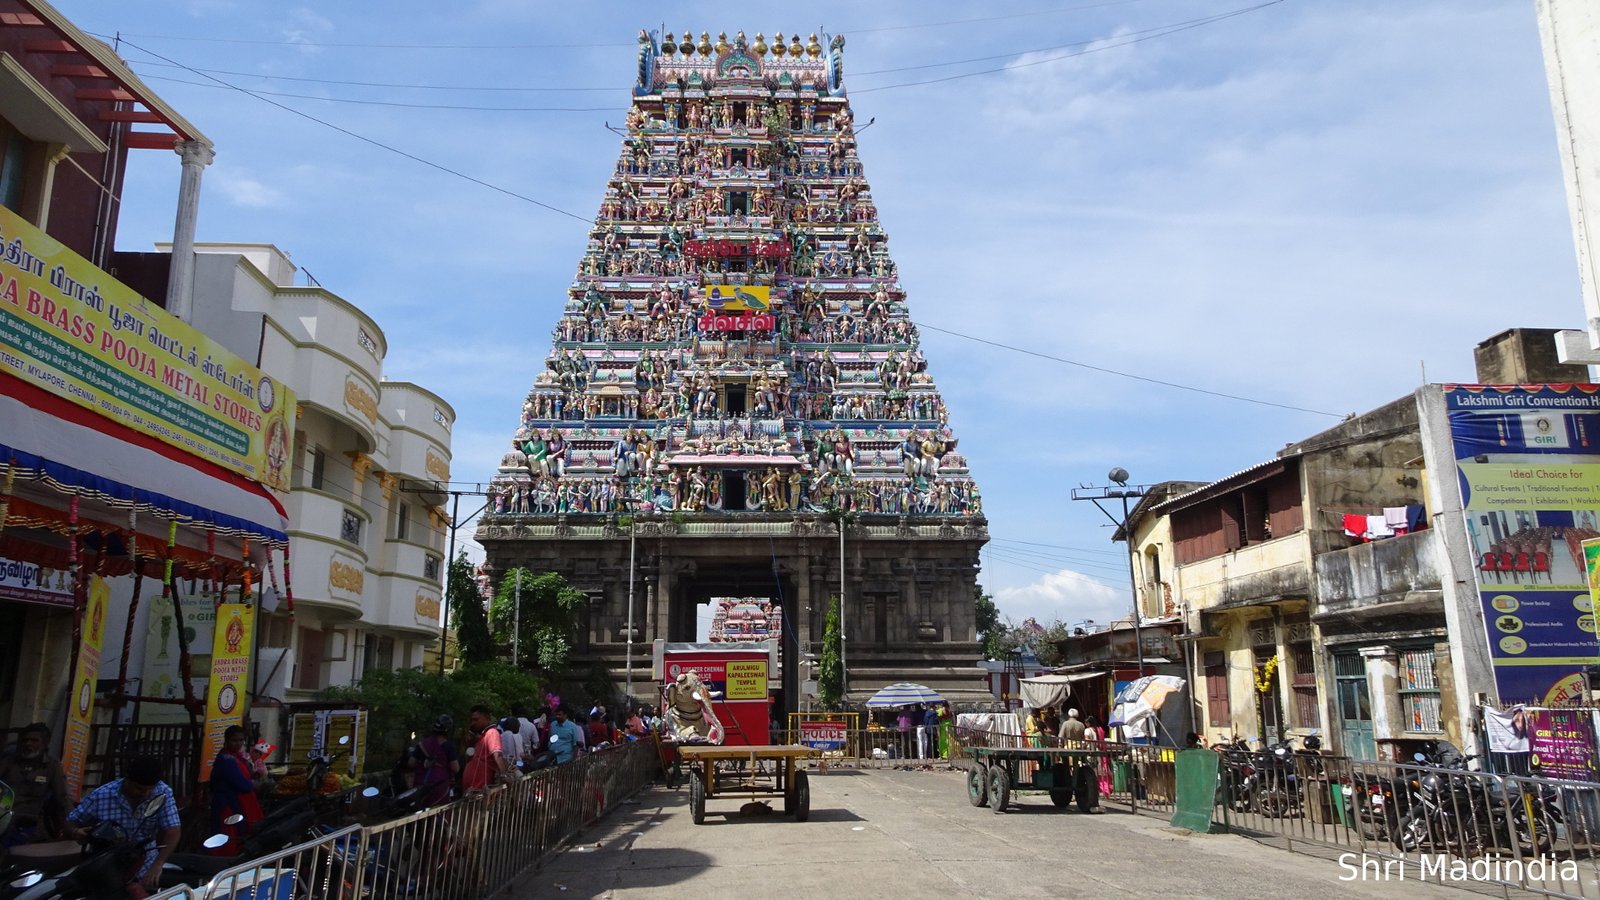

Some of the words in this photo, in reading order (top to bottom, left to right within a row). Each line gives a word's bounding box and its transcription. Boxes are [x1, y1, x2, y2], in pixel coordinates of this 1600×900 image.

[50, 266, 104, 313] பிராஸ்
[109, 303, 144, 336] பூஜா
[149, 326, 198, 368] மெட்டல்
[202, 355, 254, 399] ஸ்டோர்ஸ்
[26, 288, 96, 344] BRASS
[100, 330, 156, 379] POOJA
[162, 364, 209, 405] METAL
[214, 393, 262, 431] STORES
[28, 364, 67, 391] MYLAPORE,
[68, 384, 97, 401] CHENNAI
[1457, 394, 1502, 407] Lakshmi
[1505, 394, 1525, 407] Giri
[1527, 395, 1588, 408] Convention
[1535, 436, 1556, 444] GIRI
[1510, 469, 1534, 479] Ideal
[1536, 469, 1568, 479] Choice
[1570, 468, 1583, 479] for
[1474, 484, 1499, 492] Cultural
[1561, 485, 1590, 493] Functions
[1486, 496, 1527, 505] Competitions
[803, 730, 844, 739] POLICE
